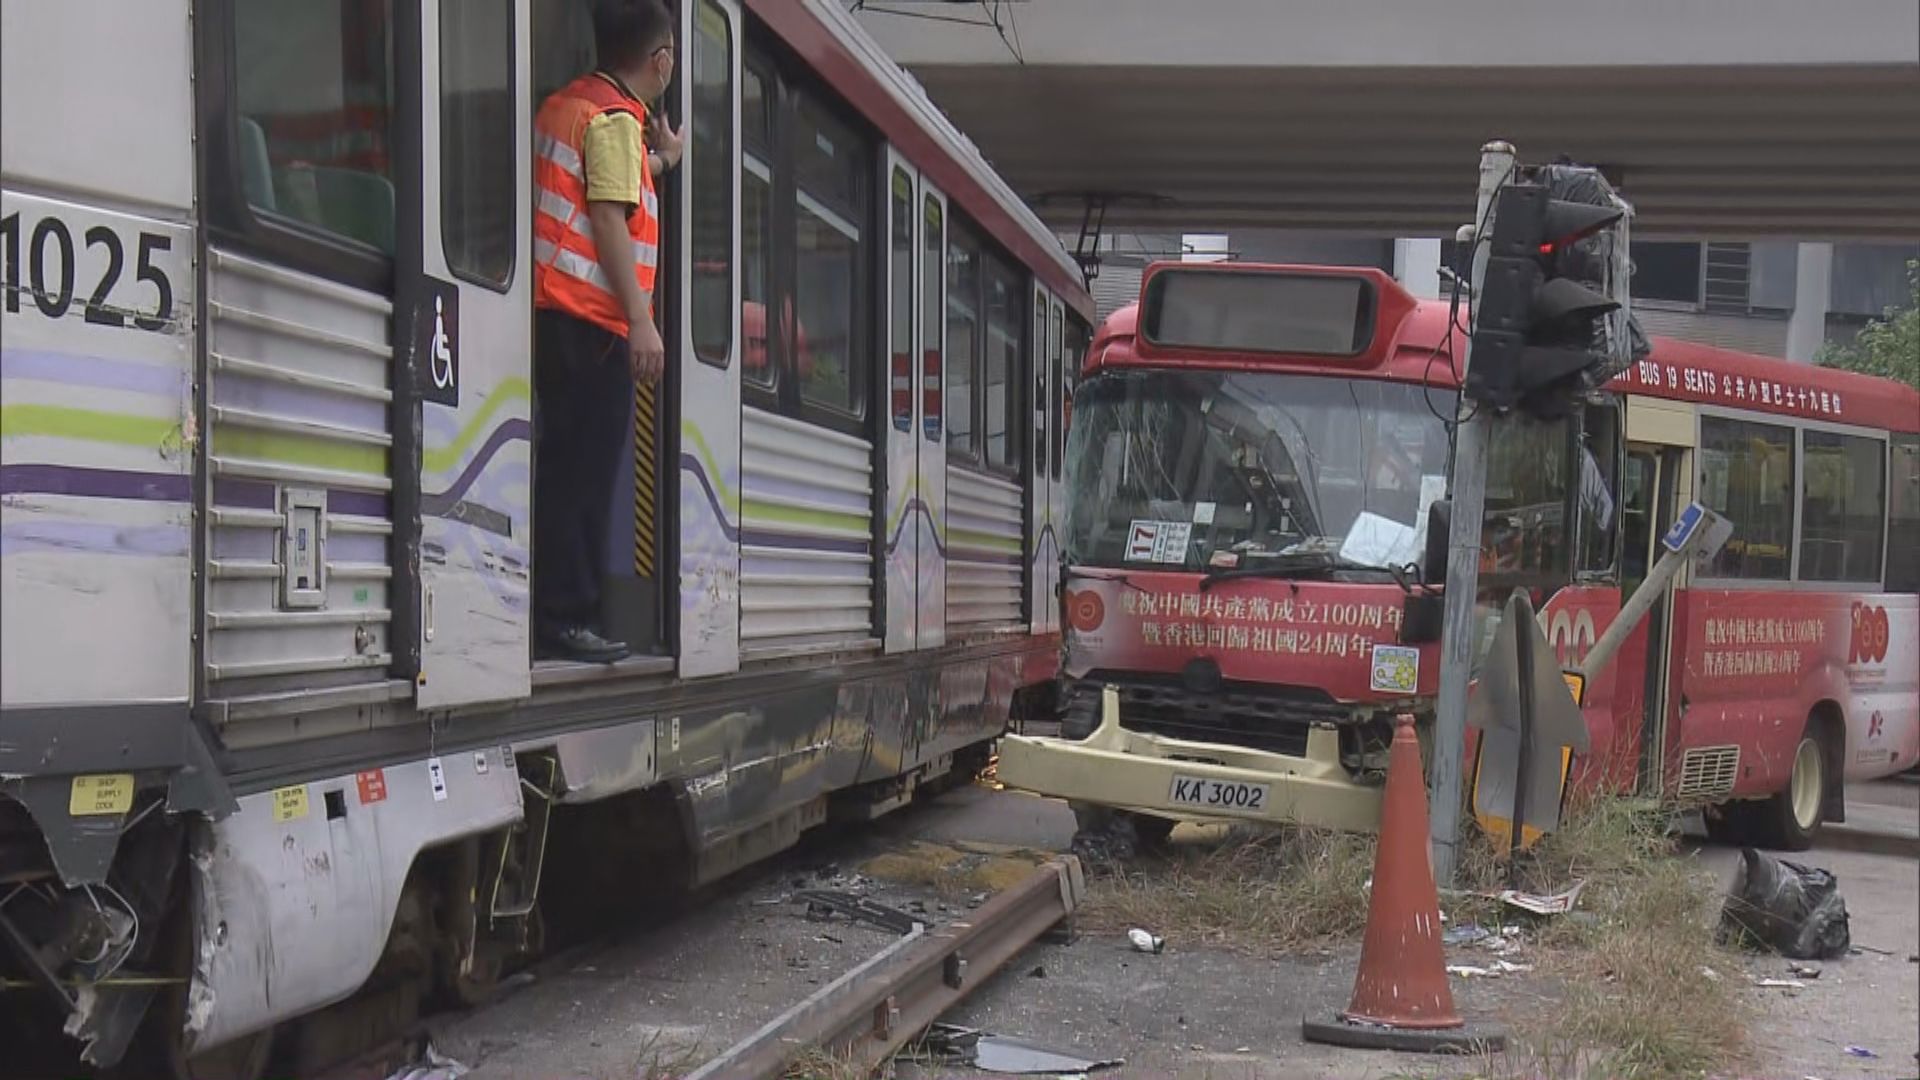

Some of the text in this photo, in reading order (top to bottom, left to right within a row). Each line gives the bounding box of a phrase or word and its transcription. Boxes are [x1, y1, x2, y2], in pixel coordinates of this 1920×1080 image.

[2, 211, 173, 331] 1025
[1639, 360, 1660, 385] BUS
[1666, 365, 1677, 390] 19
[1684, 367, 1716, 395] SEATS
[1133, 527, 1154, 555] 17
[1142, 621, 1372, 658] 暨香港回歸祖國24周年
[1175, 779, 1263, 809] KA 3002
